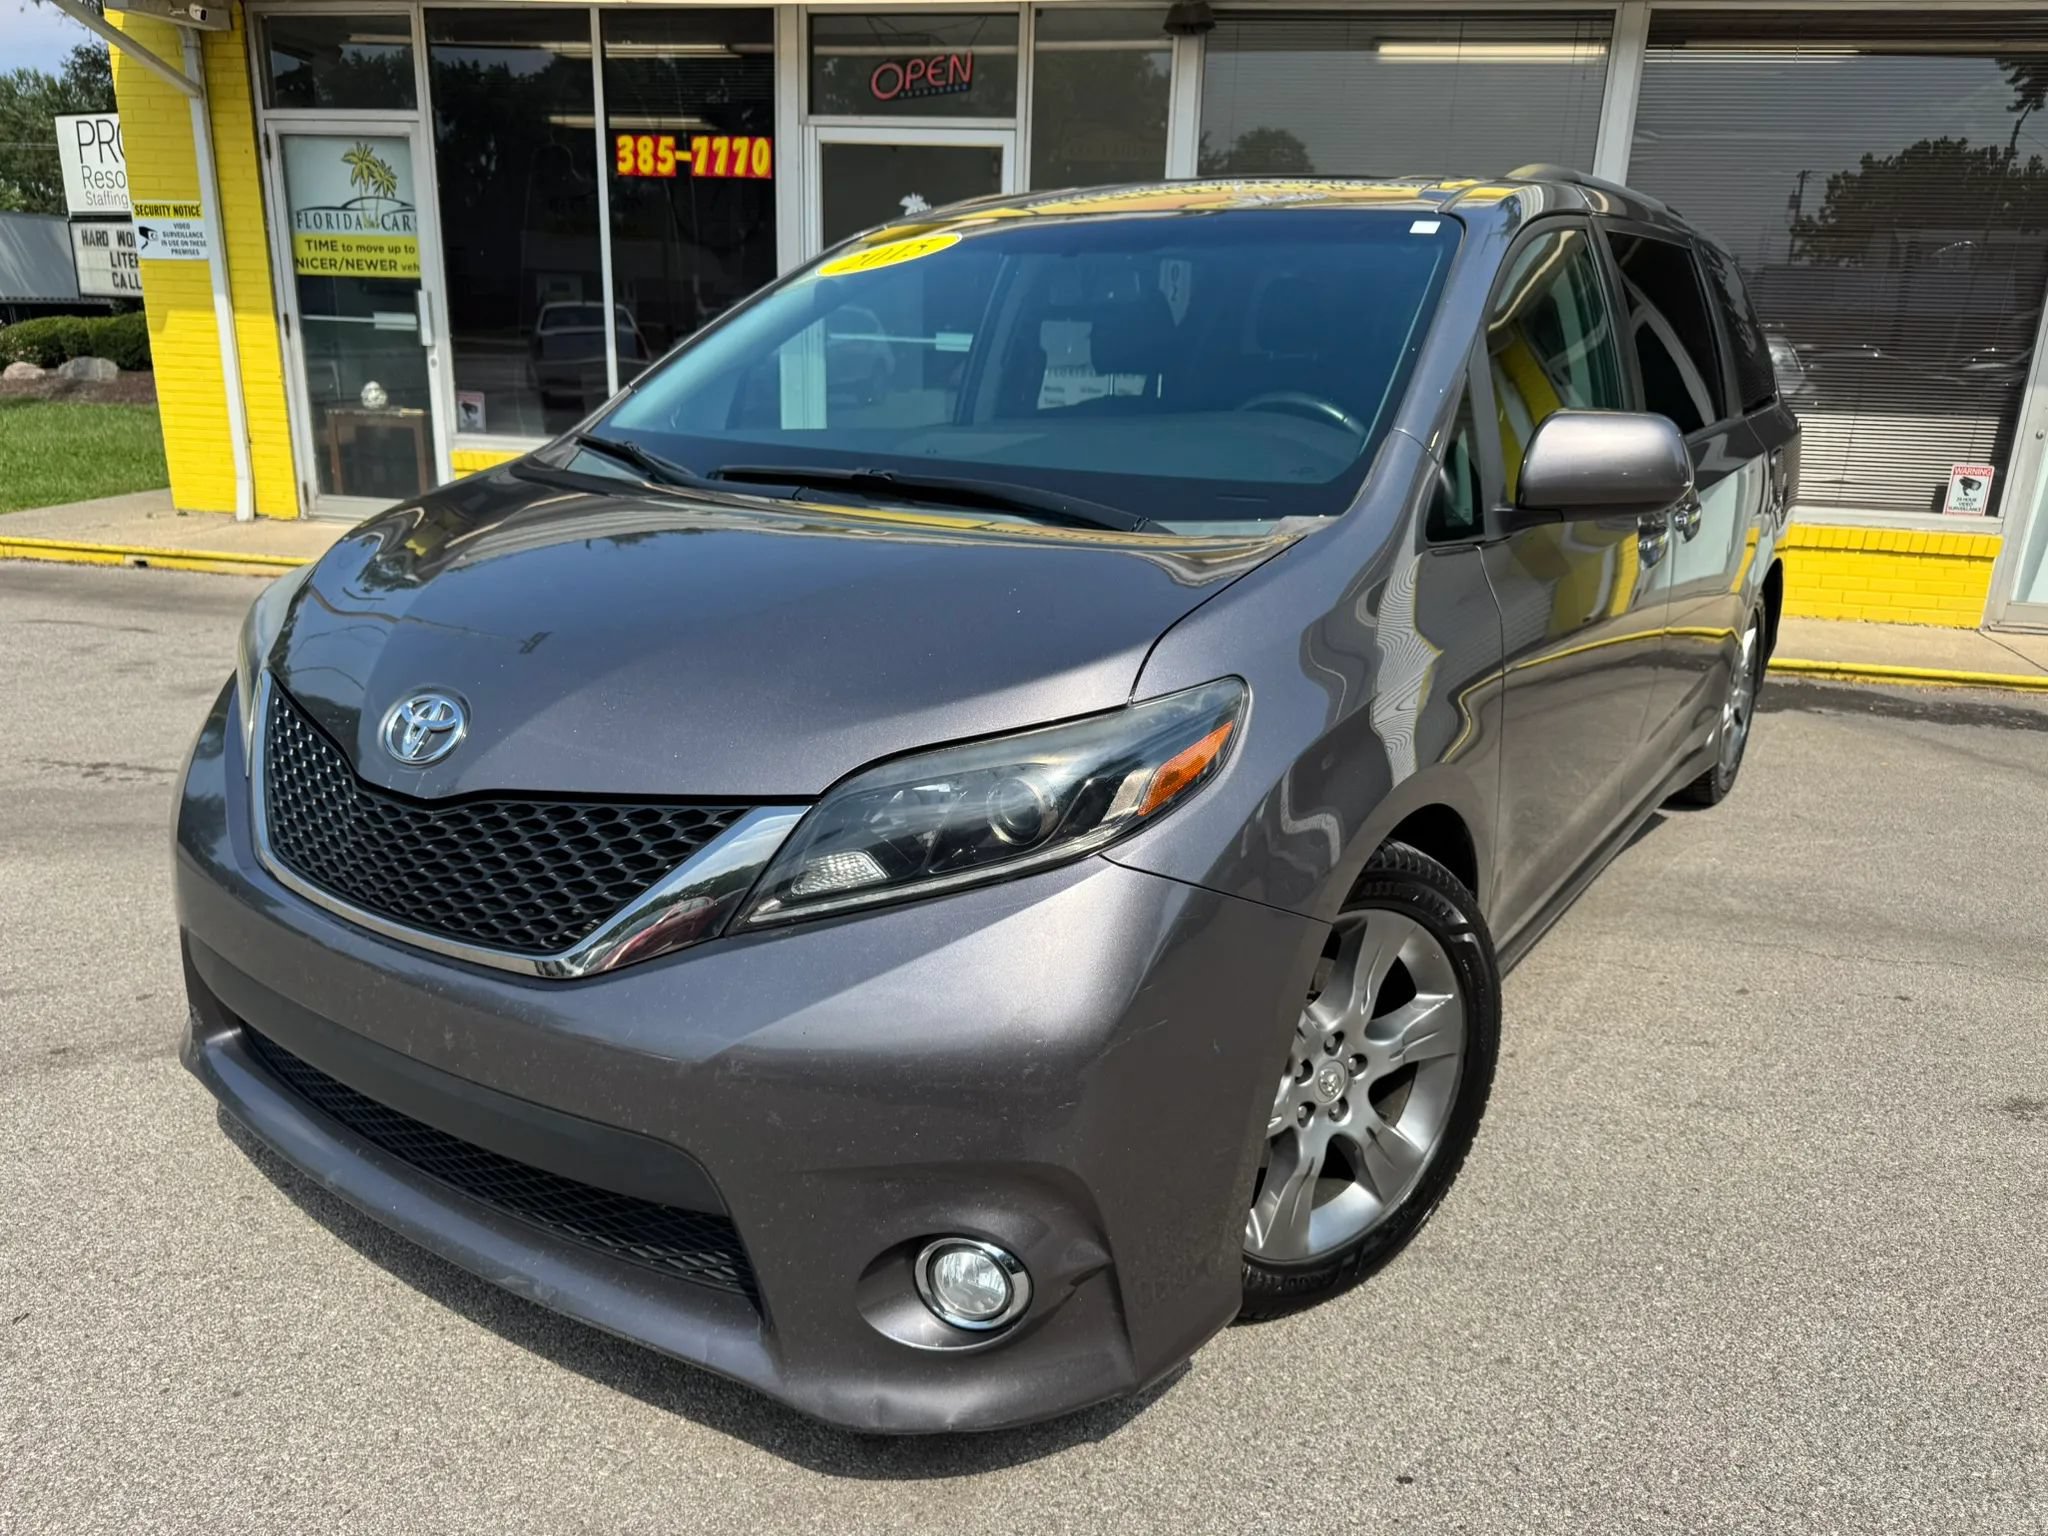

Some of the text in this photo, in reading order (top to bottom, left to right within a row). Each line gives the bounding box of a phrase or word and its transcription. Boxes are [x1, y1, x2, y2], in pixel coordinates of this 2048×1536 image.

[871, 50, 972, 100] OPEN
[616, 135, 770, 176] 385-7770
[85, 190, 128, 209] Staffing
[134, 204, 201, 217] SECURITY NOTICE
[296, 211, 363, 230] FLORIDA
[81, 229, 136, 248] HARD WO
[162, 231, 203, 239] SURVEILLANCE
[189, 240, 207, 248] THESE
[171, 248, 200, 256] PREMISES
[305, 239, 416, 257] TIME to move up to
[296, 257, 398, 272] NICER/NEWER
[112, 271, 142, 290] CALL
[1954, 466, 1991, 476] WARNING
